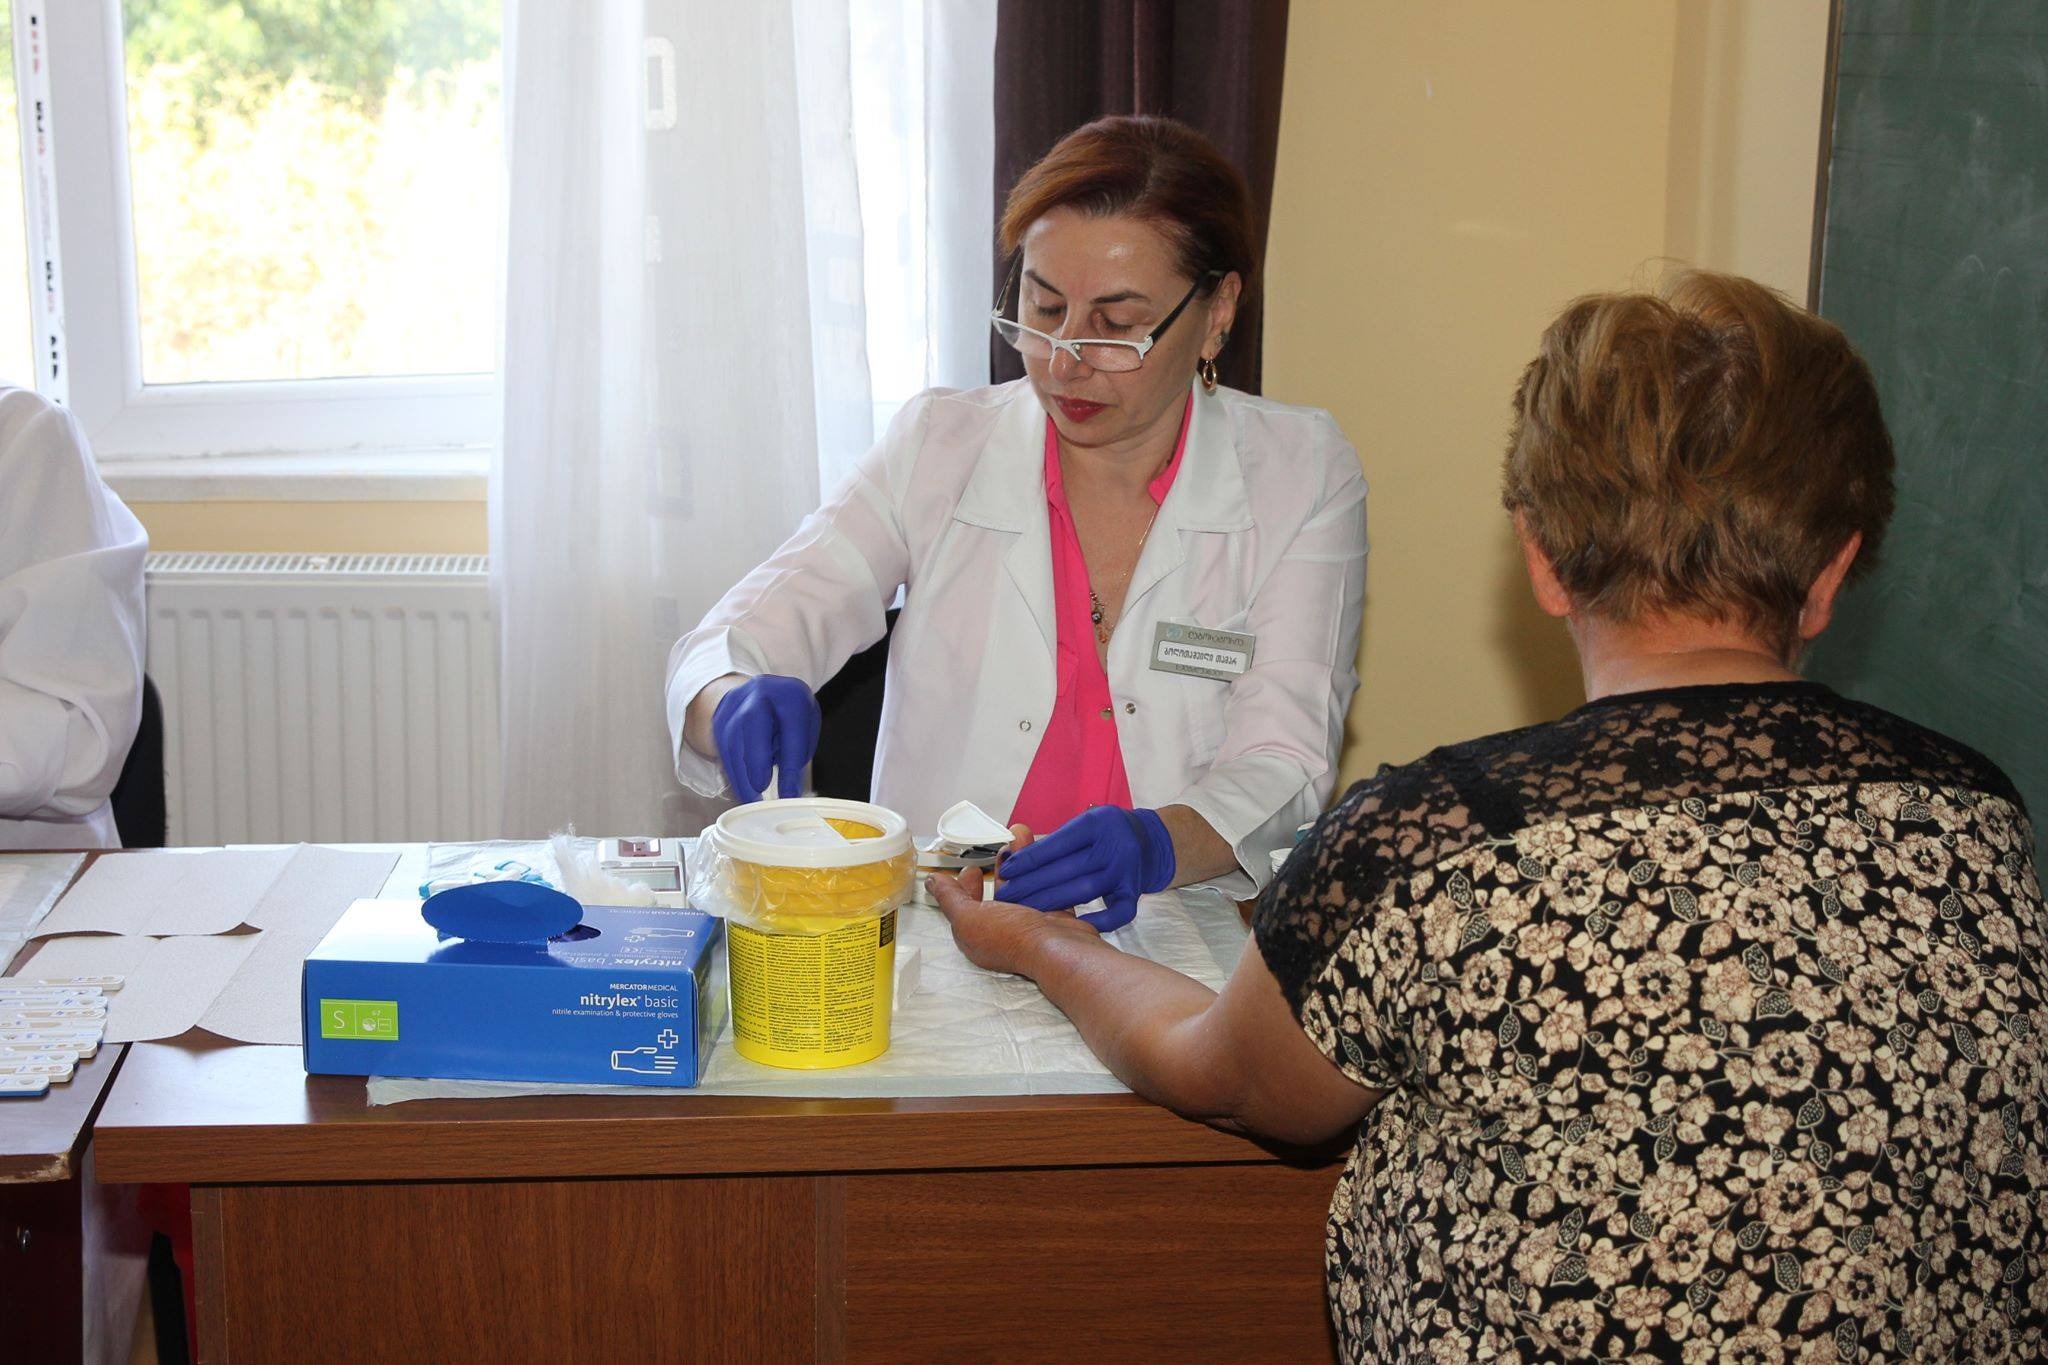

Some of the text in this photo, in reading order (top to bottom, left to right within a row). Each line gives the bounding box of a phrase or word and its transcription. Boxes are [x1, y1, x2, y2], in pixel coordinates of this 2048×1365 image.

[644, 994, 679, 1009] basic
[333, 1010, 345, 1029] S
[552, 1008, 572, 1016] nitrile
[573, 1009, 614, 1017] examination
[622, 1010, 656, 1019] protective
[657, 1012, 679, 1020] gloves
